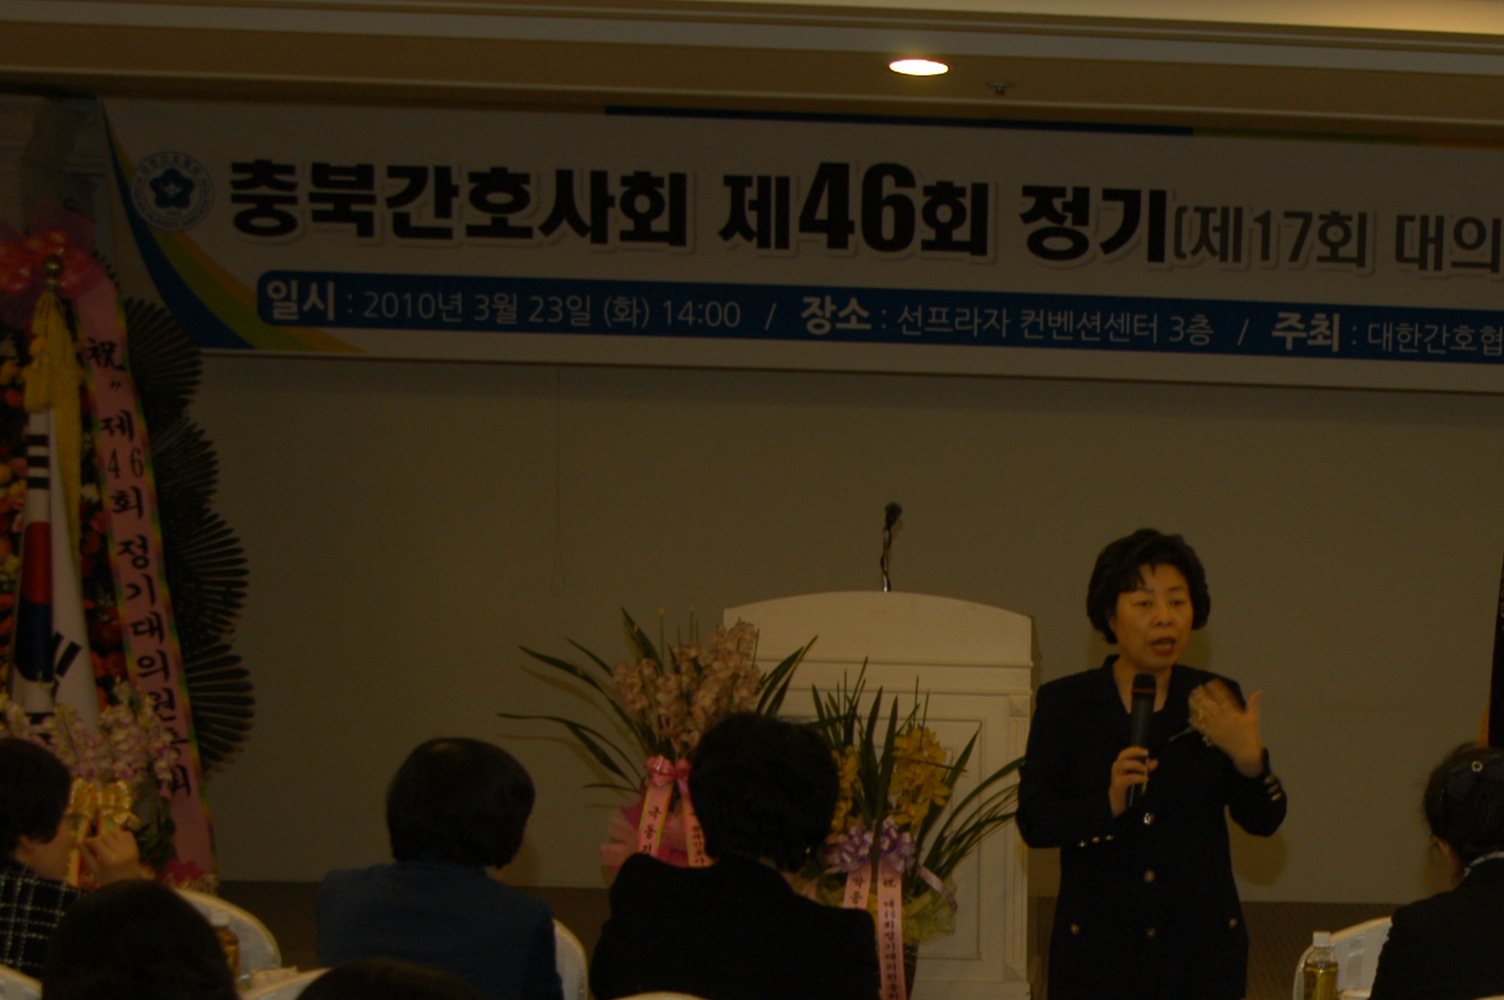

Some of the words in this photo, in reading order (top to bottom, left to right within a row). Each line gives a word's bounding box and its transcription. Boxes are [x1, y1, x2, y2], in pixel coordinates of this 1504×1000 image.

[230, 159, 687, 247] 충북간호사회
[717, 162, 988, 257] 제46회
[266, 280, 335, 320] 일시
[362, 291, 464, 323] 2010년
[473, 292, 518, 325] 3월
[529, 294, 592, 328] 23일
[603, 296, 650, 329] (화)
[662, 299, 741, 329] 14:00
[801, 296, 872, 335] 장소
[896, 303, 1009, 339] 선프라자
[1019, 308, 1158, 345] 컨벤션센터
[1168, 314, 1214, 347] 3층
[1271, 311, 1340, 353] 주최
